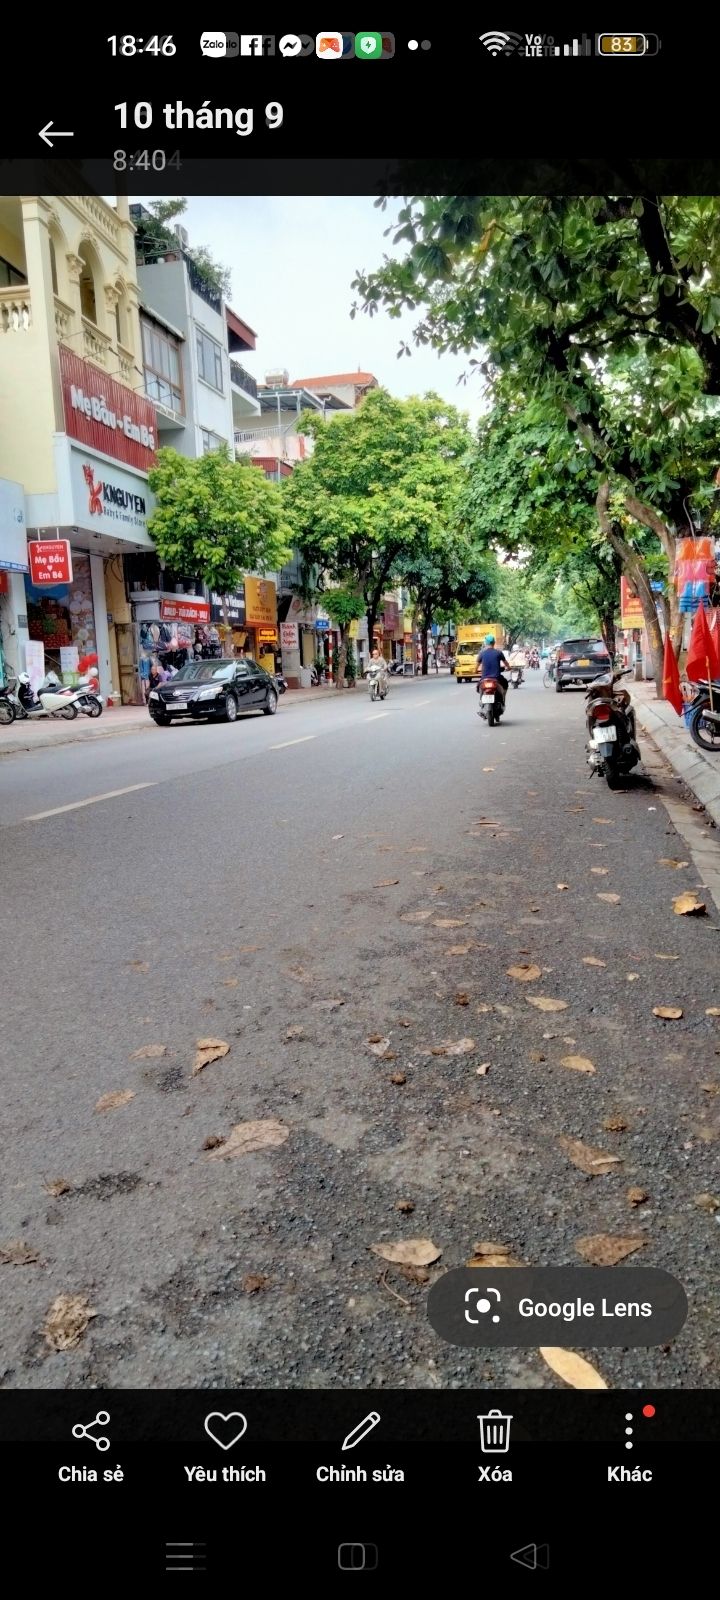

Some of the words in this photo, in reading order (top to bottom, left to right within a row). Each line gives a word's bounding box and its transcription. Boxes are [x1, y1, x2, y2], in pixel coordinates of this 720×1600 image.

[70, 384, 92, 421] Mẹ
[91, 394, 117, 430] Bầu
[123, 415, 141, 443] Em
[140, 424, 155, 451] Bé
[102, 482, 146, 515] KNGUYEN
[34, 556, 47, 565] Mẹ
[48, 554, 65, 563] Bầu
[38, 572, 51, 580] Em
[52, 570, 63, 579] Bé
